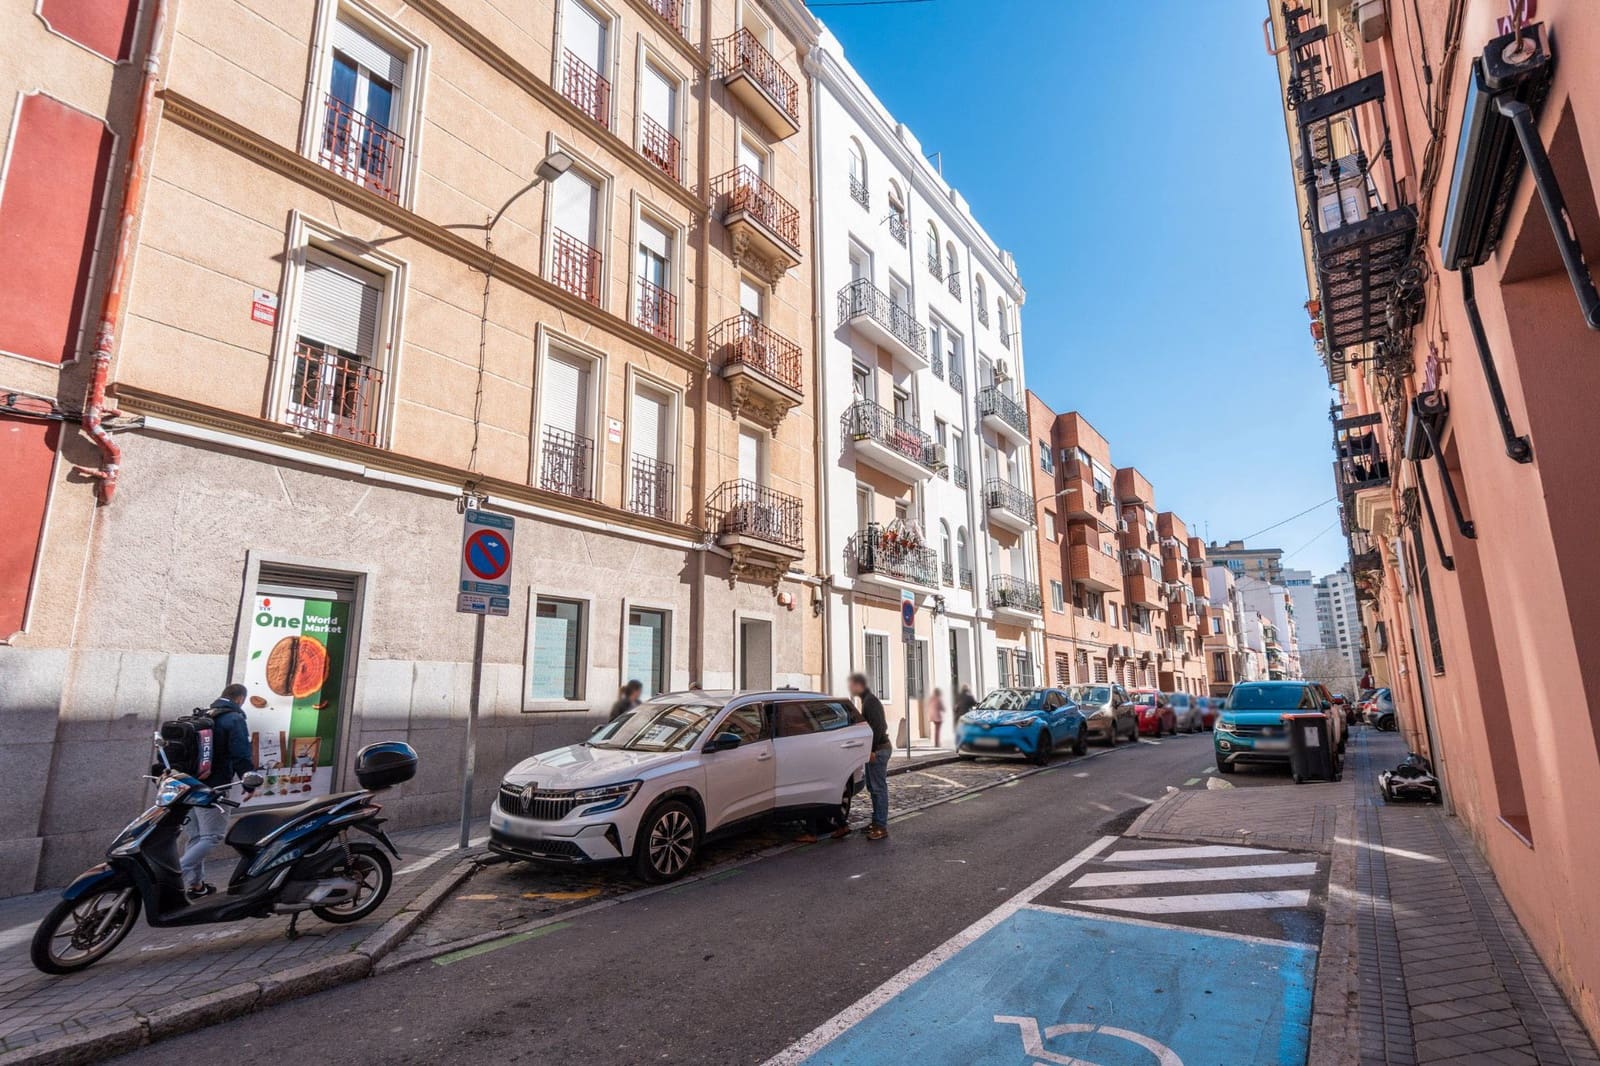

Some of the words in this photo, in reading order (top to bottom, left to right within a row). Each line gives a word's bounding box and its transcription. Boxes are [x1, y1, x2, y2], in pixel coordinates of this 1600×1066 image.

[255, 612, 300, 628] One
[306, 615, 338, 625] World
[305, 624, 341, 633] Market
